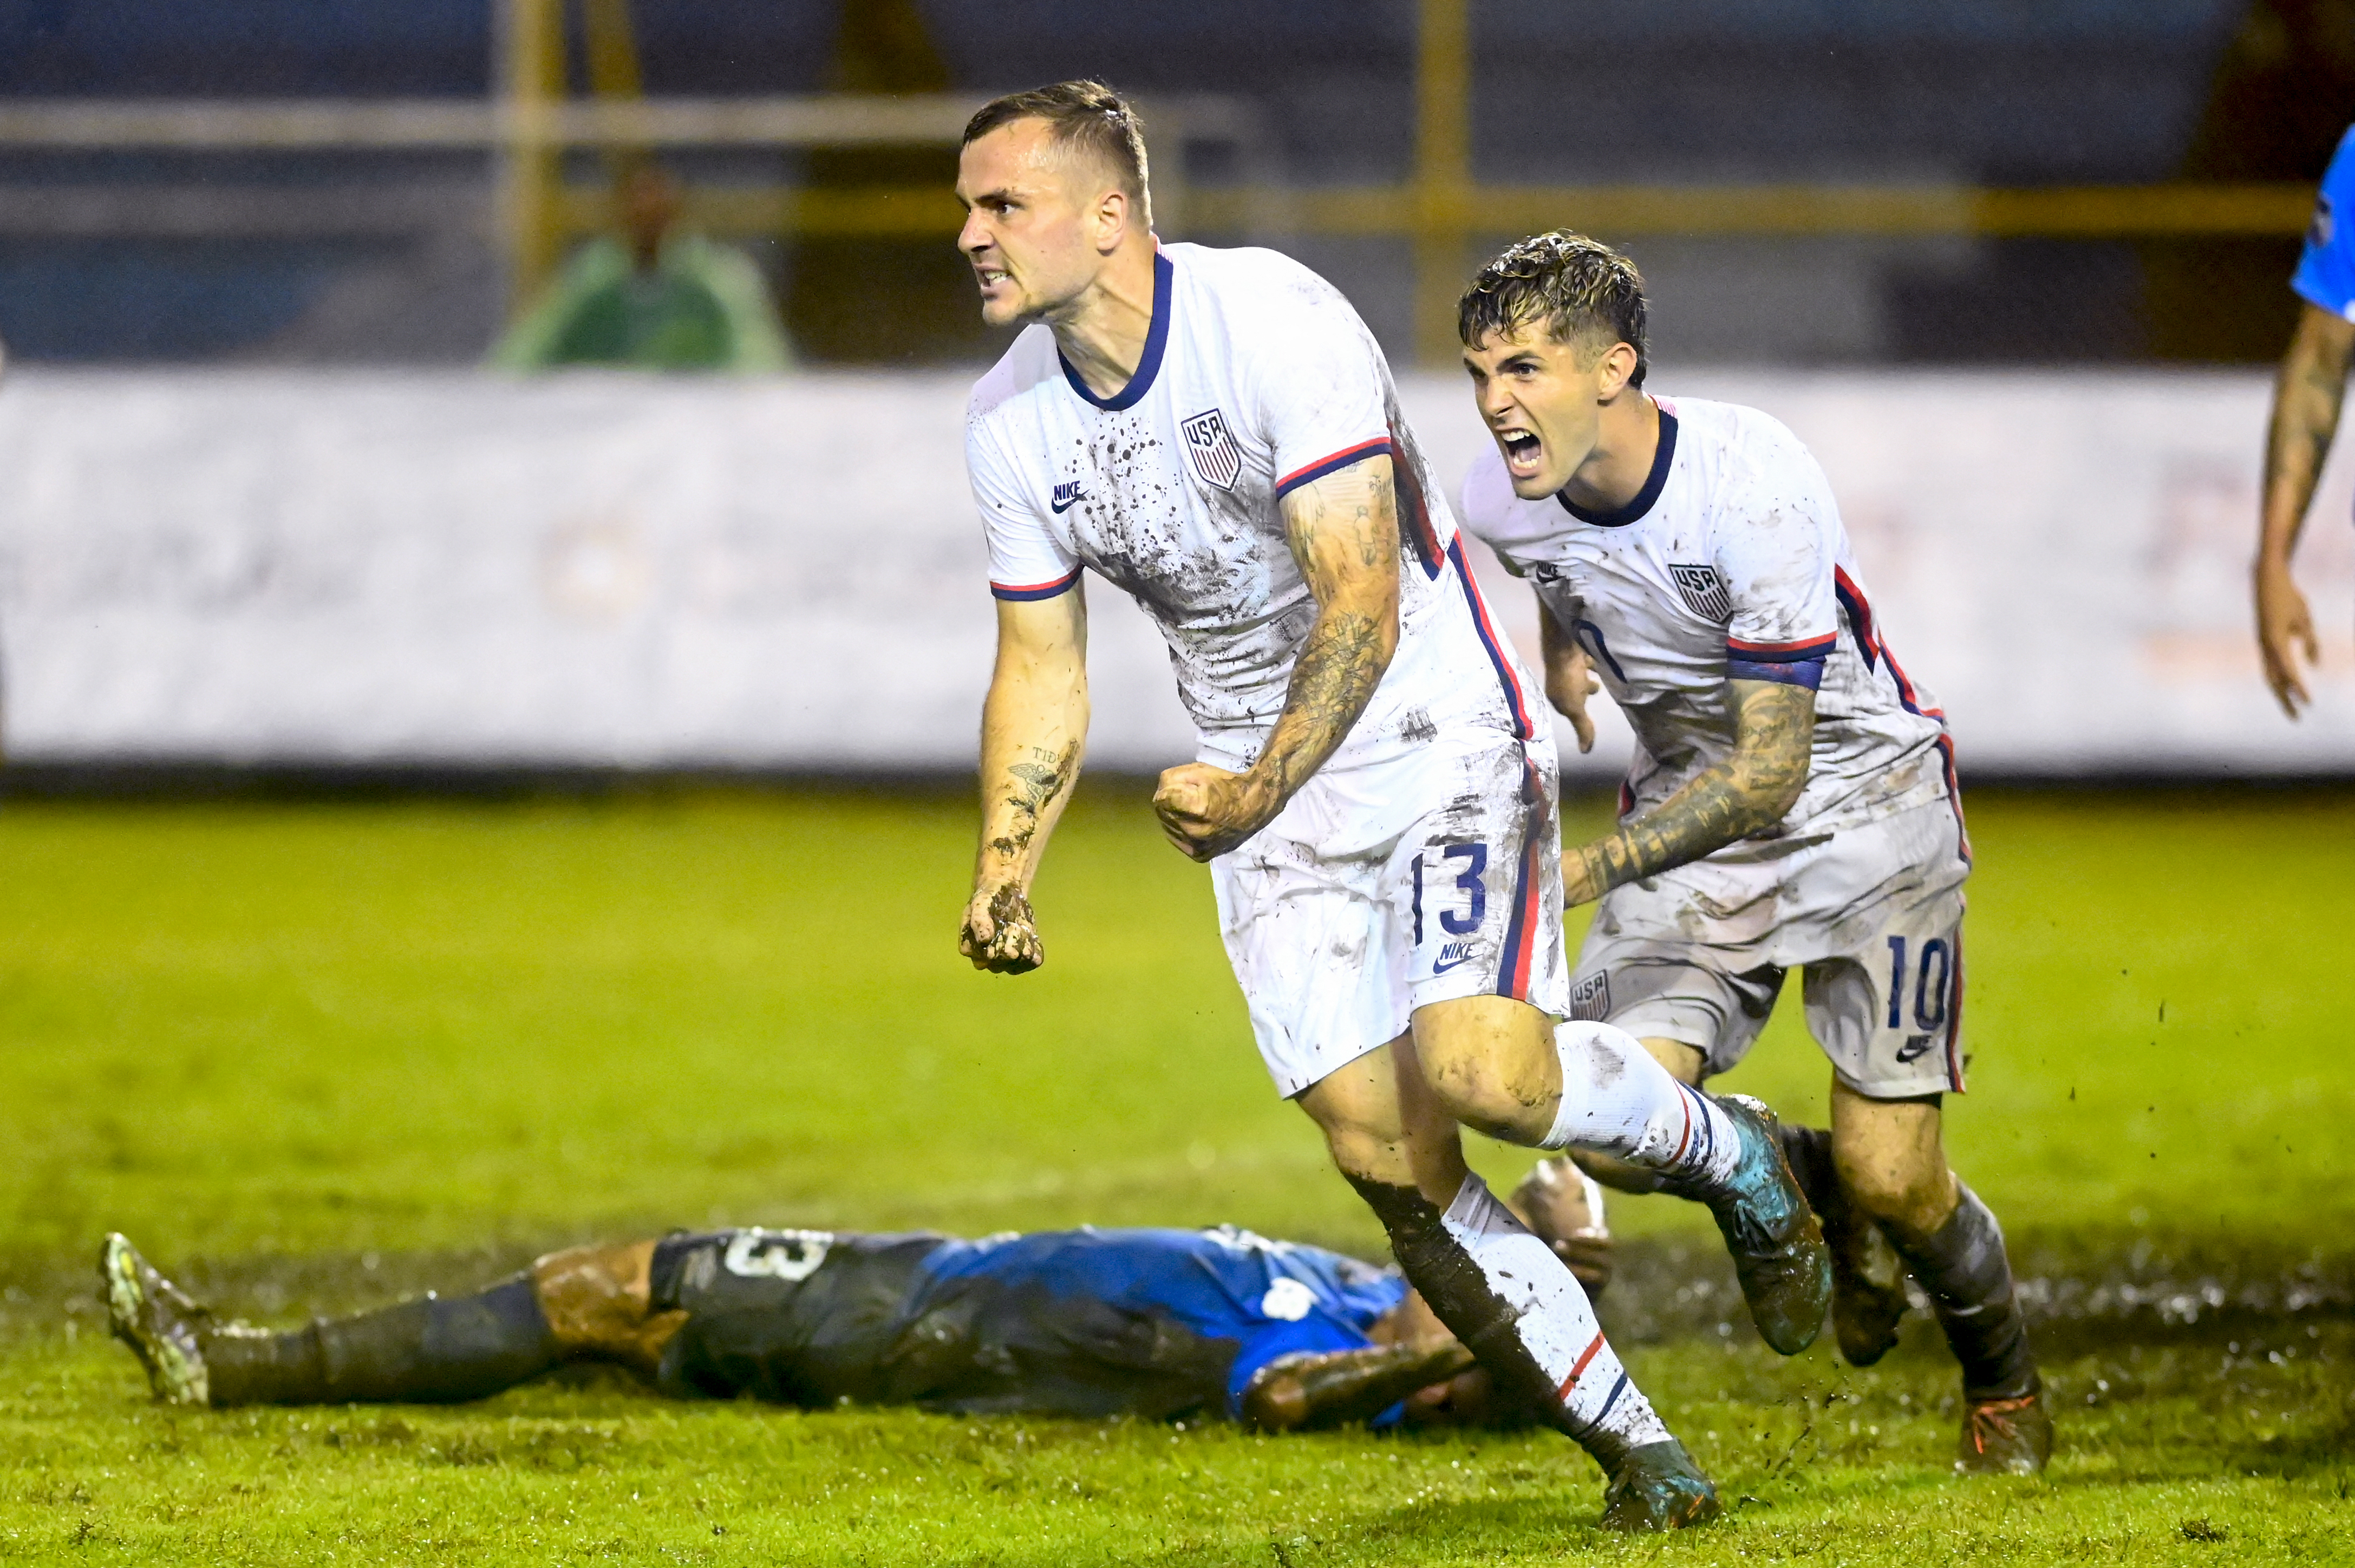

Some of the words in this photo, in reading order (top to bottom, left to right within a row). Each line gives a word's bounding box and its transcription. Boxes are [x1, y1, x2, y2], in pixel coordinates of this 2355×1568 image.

[1187, 416, 1221, 447] USA
[1054, 480, 1080, 501] NIKE
[1674, 570, 1715, 591] USA
[1410, 843, 1488, 947] 13
[1439, 943, 1476, 960] NIKE
[1575, 976, 1603, 1002] USA
[1888, 936, 1949, 1031] 10
